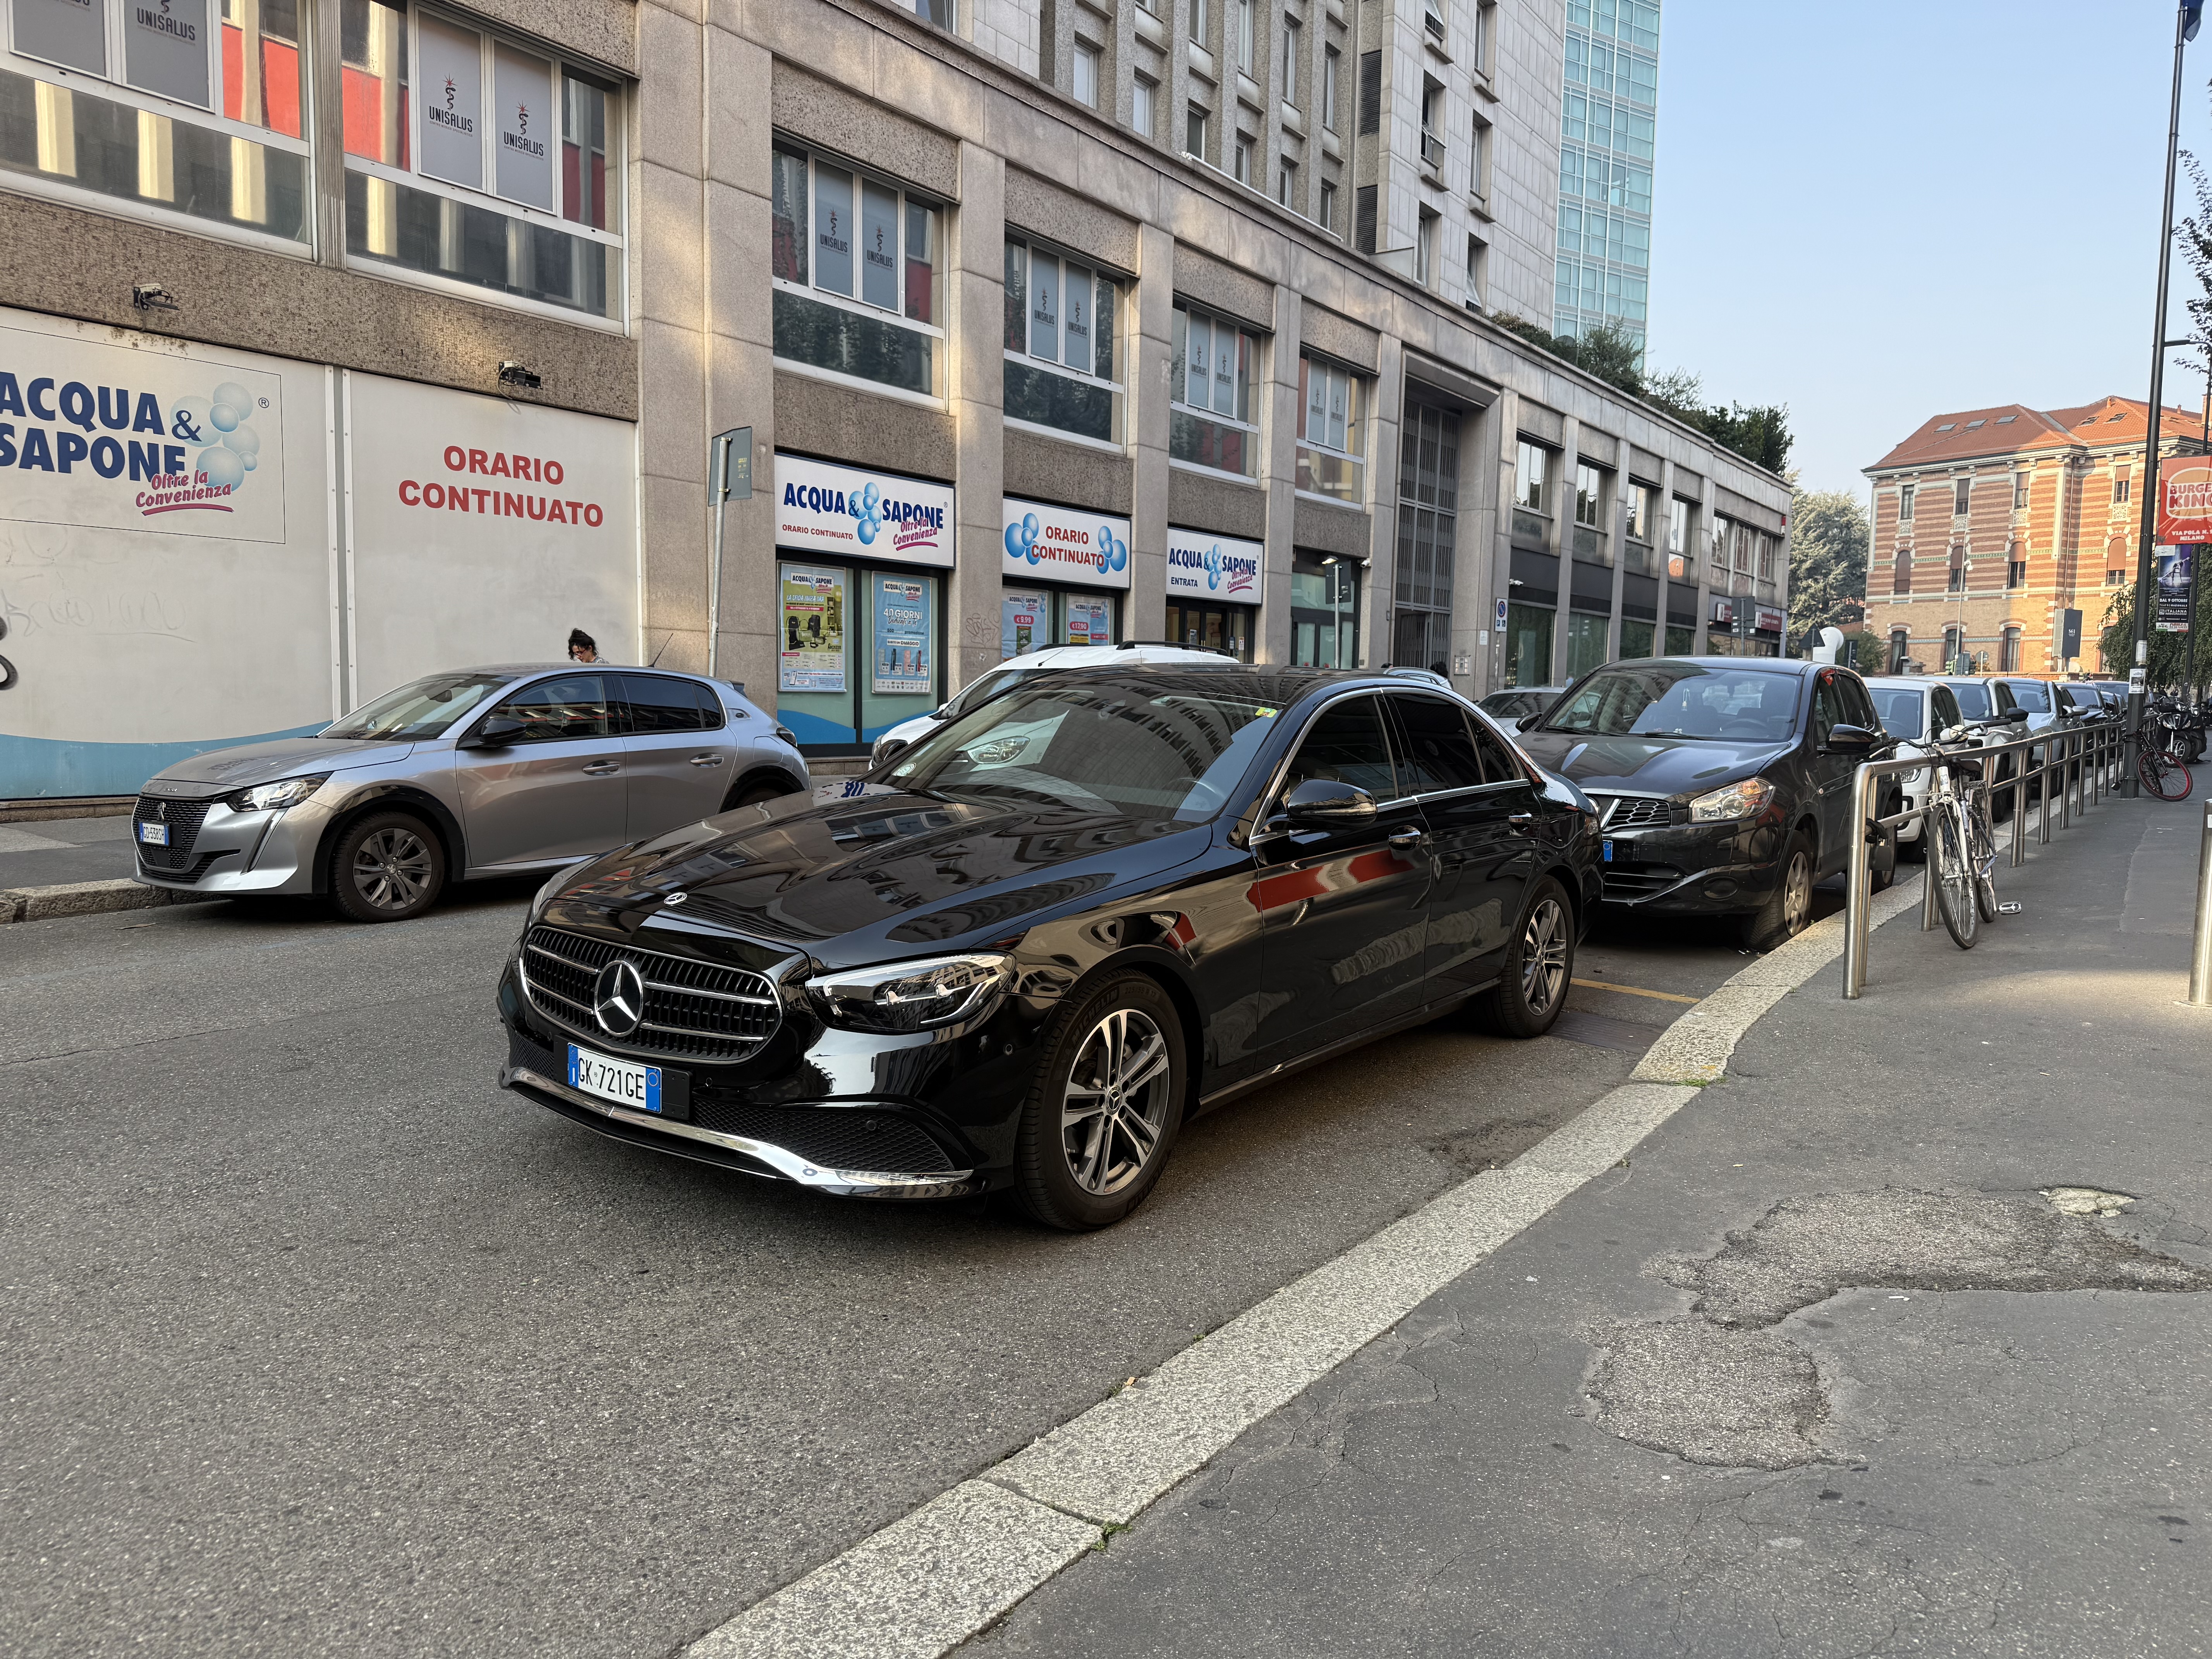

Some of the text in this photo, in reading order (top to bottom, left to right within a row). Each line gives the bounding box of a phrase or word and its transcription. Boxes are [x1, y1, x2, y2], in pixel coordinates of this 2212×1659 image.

[137, 7, 195, 40] UNISALUS
[429, 106, 472, 132] UNISALUS
[504, 132, 543, 156] UNISALUS
[820, 234, 848, 252] UNISALUS
[867, 249, 893, 268] UNISALUS
[1035, 309, 1054, 325] UNISALUS
[1068, 321, 1087, 336] UNISALUS
[0, 371, 202, 441] ACQUA &
[0, 422, 185, 484] SAPONE
[444, 445, 564, 485] ORARIO
[151, 469, 208, 490] Oltre la
[136, 483, 232, 508] Convenienza
[399, 480, 603, 527] CONTINUATO
[784, 483, 943, 529] ACQUA & SAPONE
[782, 524, 853, 540] ORARIO CONTINUATO
[893, 526, 938, 545] Convenienza
[901, 517, 927, 533] Oltre la
[1046, 526, 1089, 544] ORARIO
[1032, 544, 1104, 567] CONTINUATO
[1169, 548, 1256, 575] ACQUA & SAPONE
[1171, 577, 1198, 587] ENTRATA
[895, 610, 922, 619] GIORNI
[1072, 989, 1118, 1045] MICHELIN
[579, 1058, 592, 1086] GK
